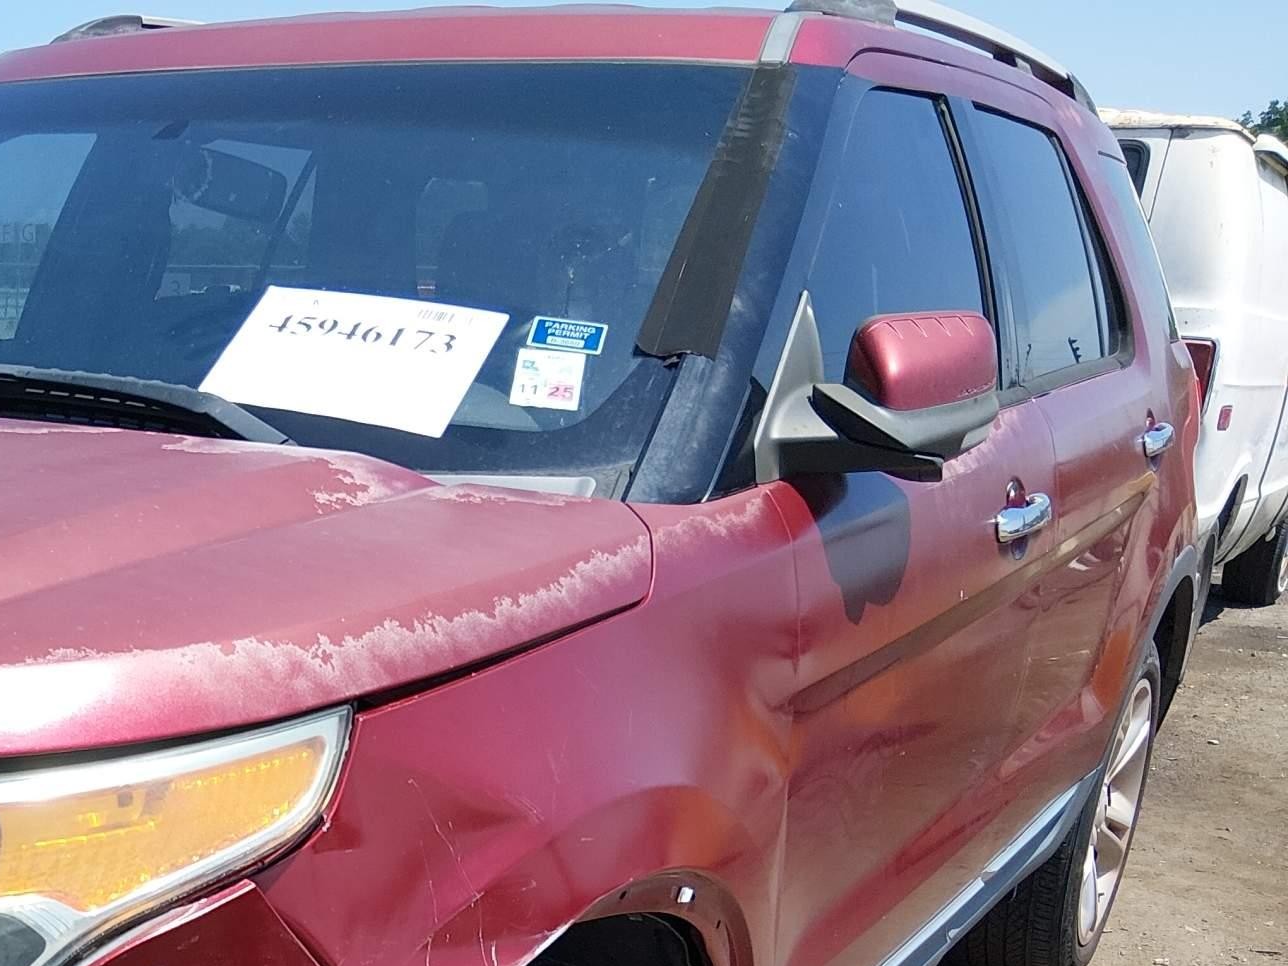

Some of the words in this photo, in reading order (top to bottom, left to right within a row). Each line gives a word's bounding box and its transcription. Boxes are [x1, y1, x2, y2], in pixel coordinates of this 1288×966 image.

[269, 314, 457, 354] 45946173
[544, 321, 596, 334] PARKING
[547, 328, 591, 340] PERMIT
[548, 386, 574, 401] 25
